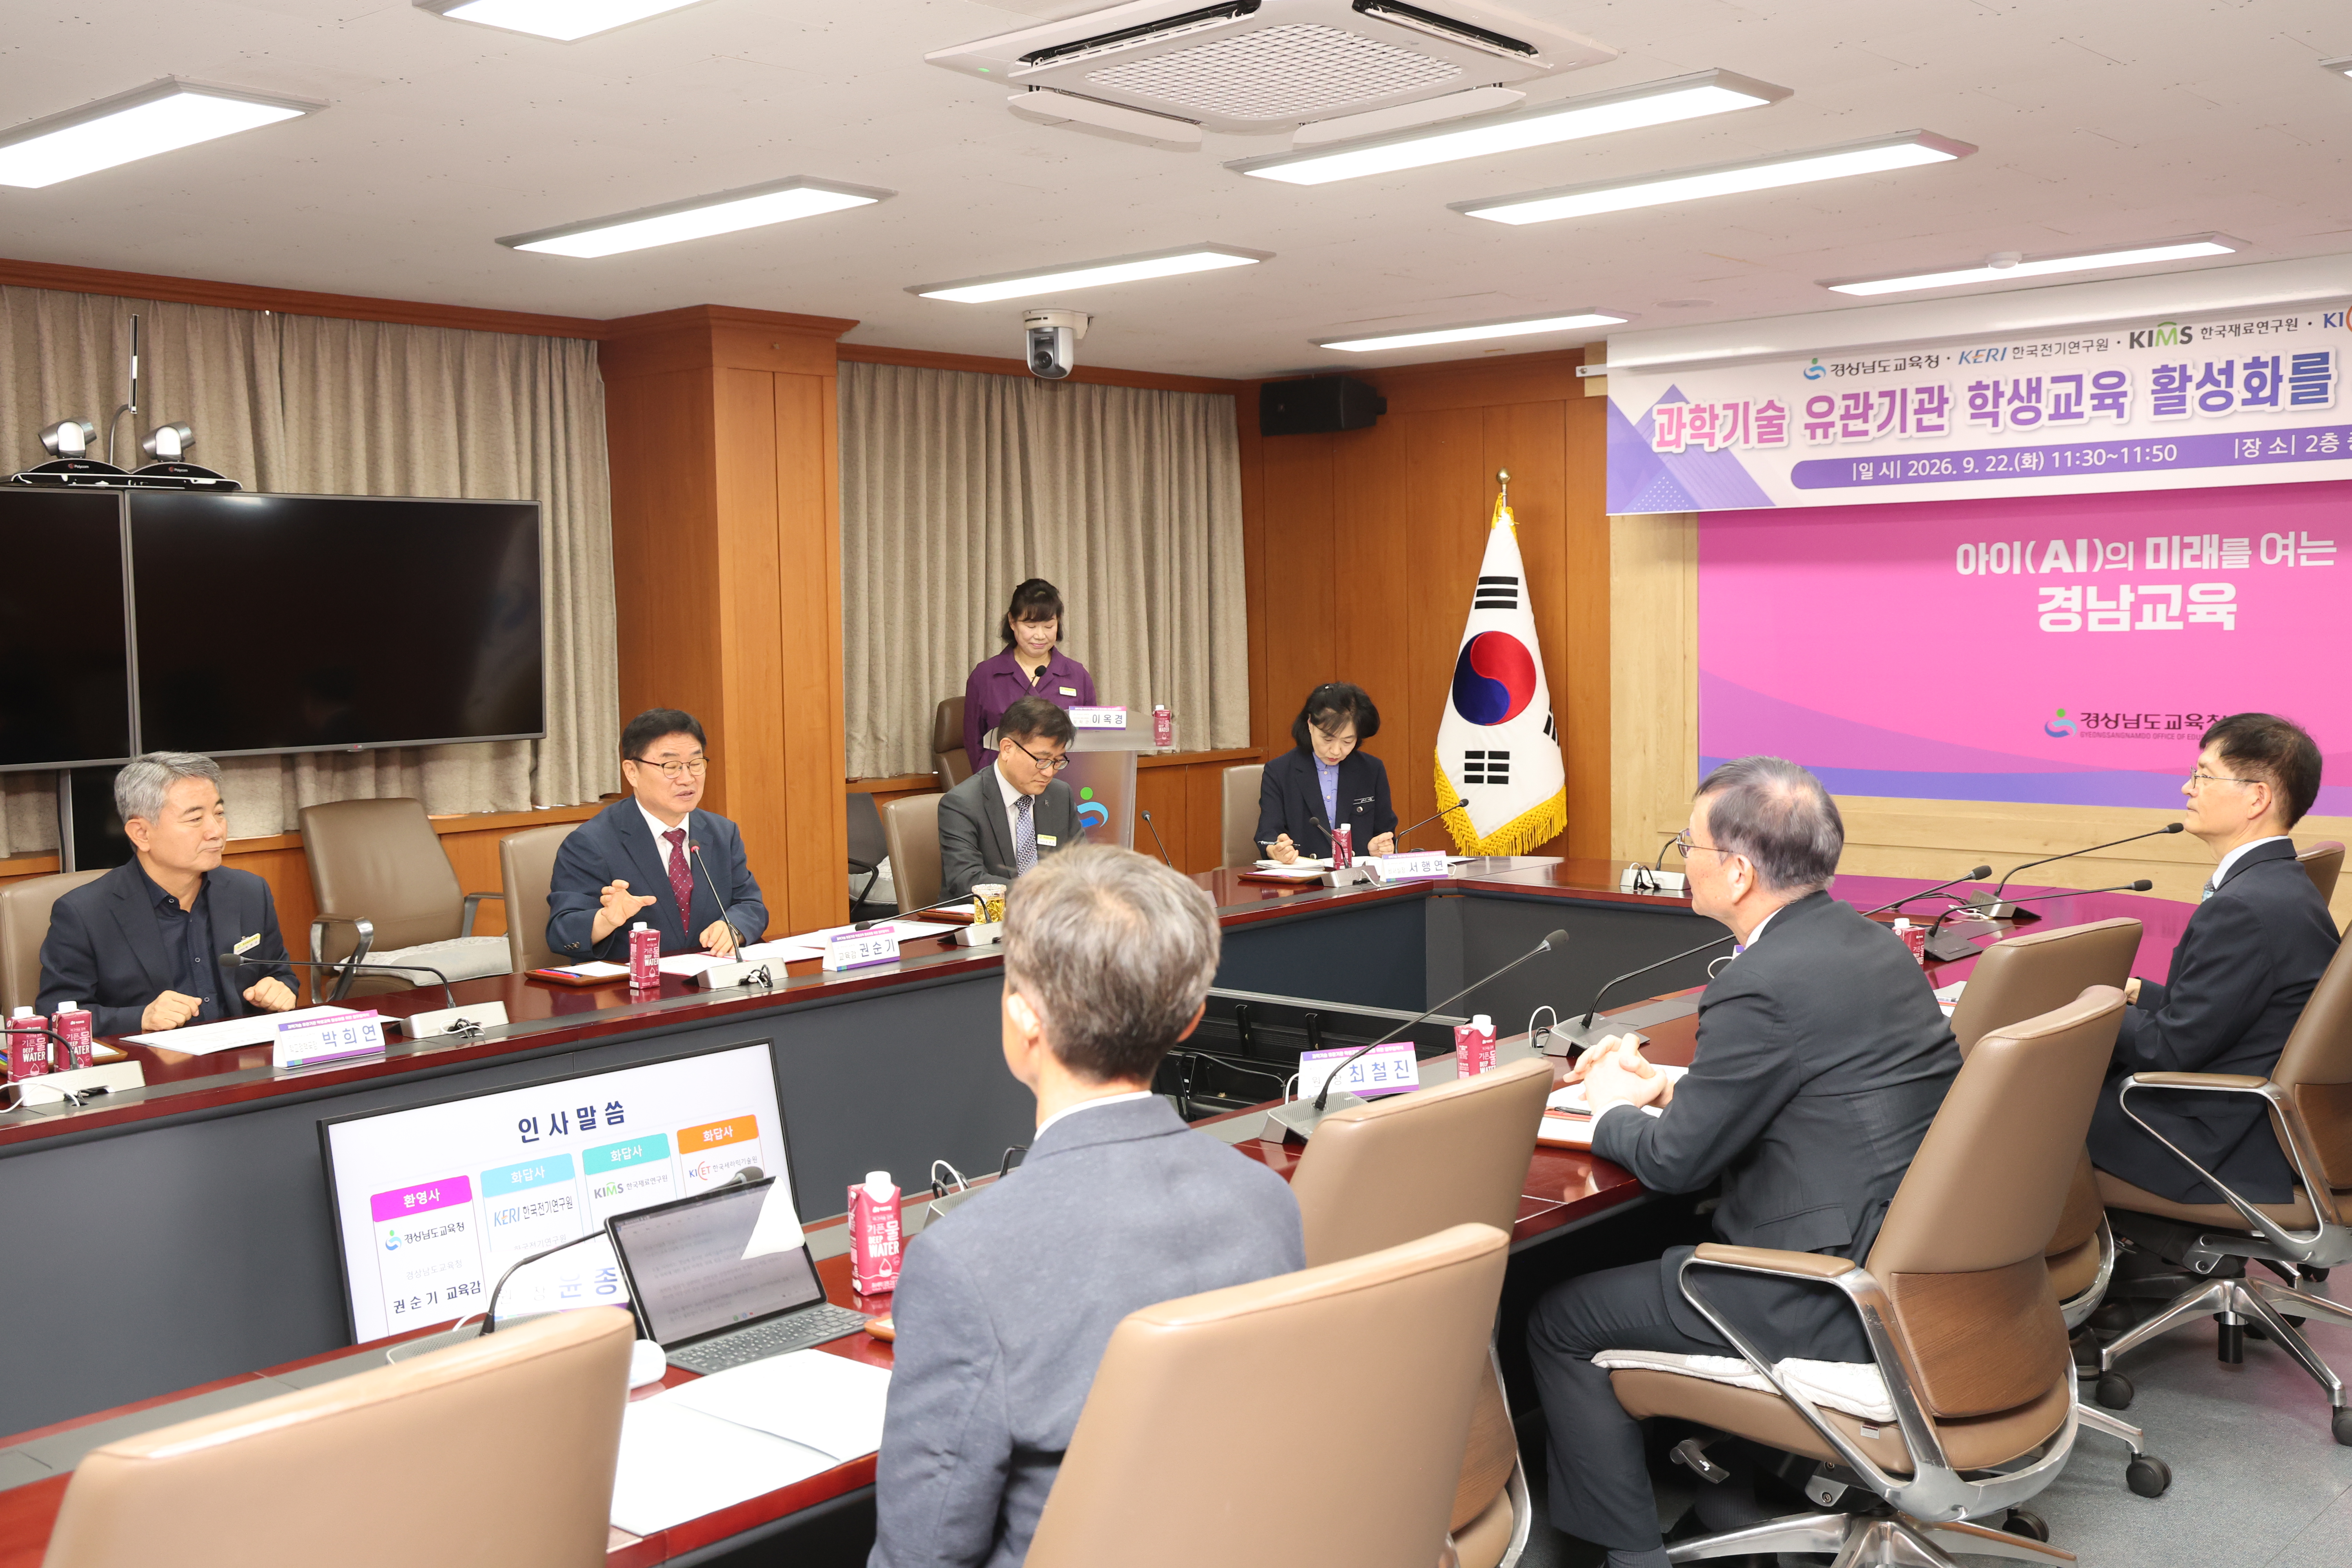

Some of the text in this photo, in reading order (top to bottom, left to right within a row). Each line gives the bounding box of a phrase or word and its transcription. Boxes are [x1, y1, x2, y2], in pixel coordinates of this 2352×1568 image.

[1830, 305, 2352, 377] 경상남도교육청 KERI 한국전기연구원 KIMS 한국재료연구원 KI
[1656, 351, 2332, 449] 과학기술 유관기관 학생교육 활성화를
[2305, 432, 2340, 453] 2층
[1907, 458, 1957, 477] 2026.
[1962, 457, 1979, 473] 9.
[1985, 450, 2045, 473] 22.(화)
[2052, 444, 2178, 468] 11:30~11:50
[1956, 531, 2337, 576] 아이(AI)의 미래를 여는
[2038, 582, 2237, 632] 경남교육
[1092, 714, 1123, 724] 이옥경
[1409, 860, 1443, 873] 서행연
[838, 938, 895, 961] 교육감 권순기
[322, 1024, 377, 1047] 박희연
[22, 1051, 46, 1062] WATER
[68, 1044, 90, 1055] ATER
[1349, 1059, 1410, 1083] 최철진
[518, 1100, 624, 1143] 인사말씀
[703, 1125, 733, 1142] 화답사
[610, 1145, 642, 1162] 화답사
[510, 1165, 545, 1183] 화답사
[688, 1156, 758, 1180] KICET 한국세라믹기술원
[593, 1174, 668, 1199] KIMS 한국재료연구원
[403, 1188, 441, 1209] 환영사
[494, 1196, 573, 1227] KERI 한국전기연구원
[404, 1221, 465, 1244] 경상남도교육청
[868, 1235, 884, 1245] DEEP
[869, 1240, 900, 1258] WATER
[406, 1259, 463, 1280] 경상남도교육청
[393, 1280, 481, 1314] 권순기 교육감
